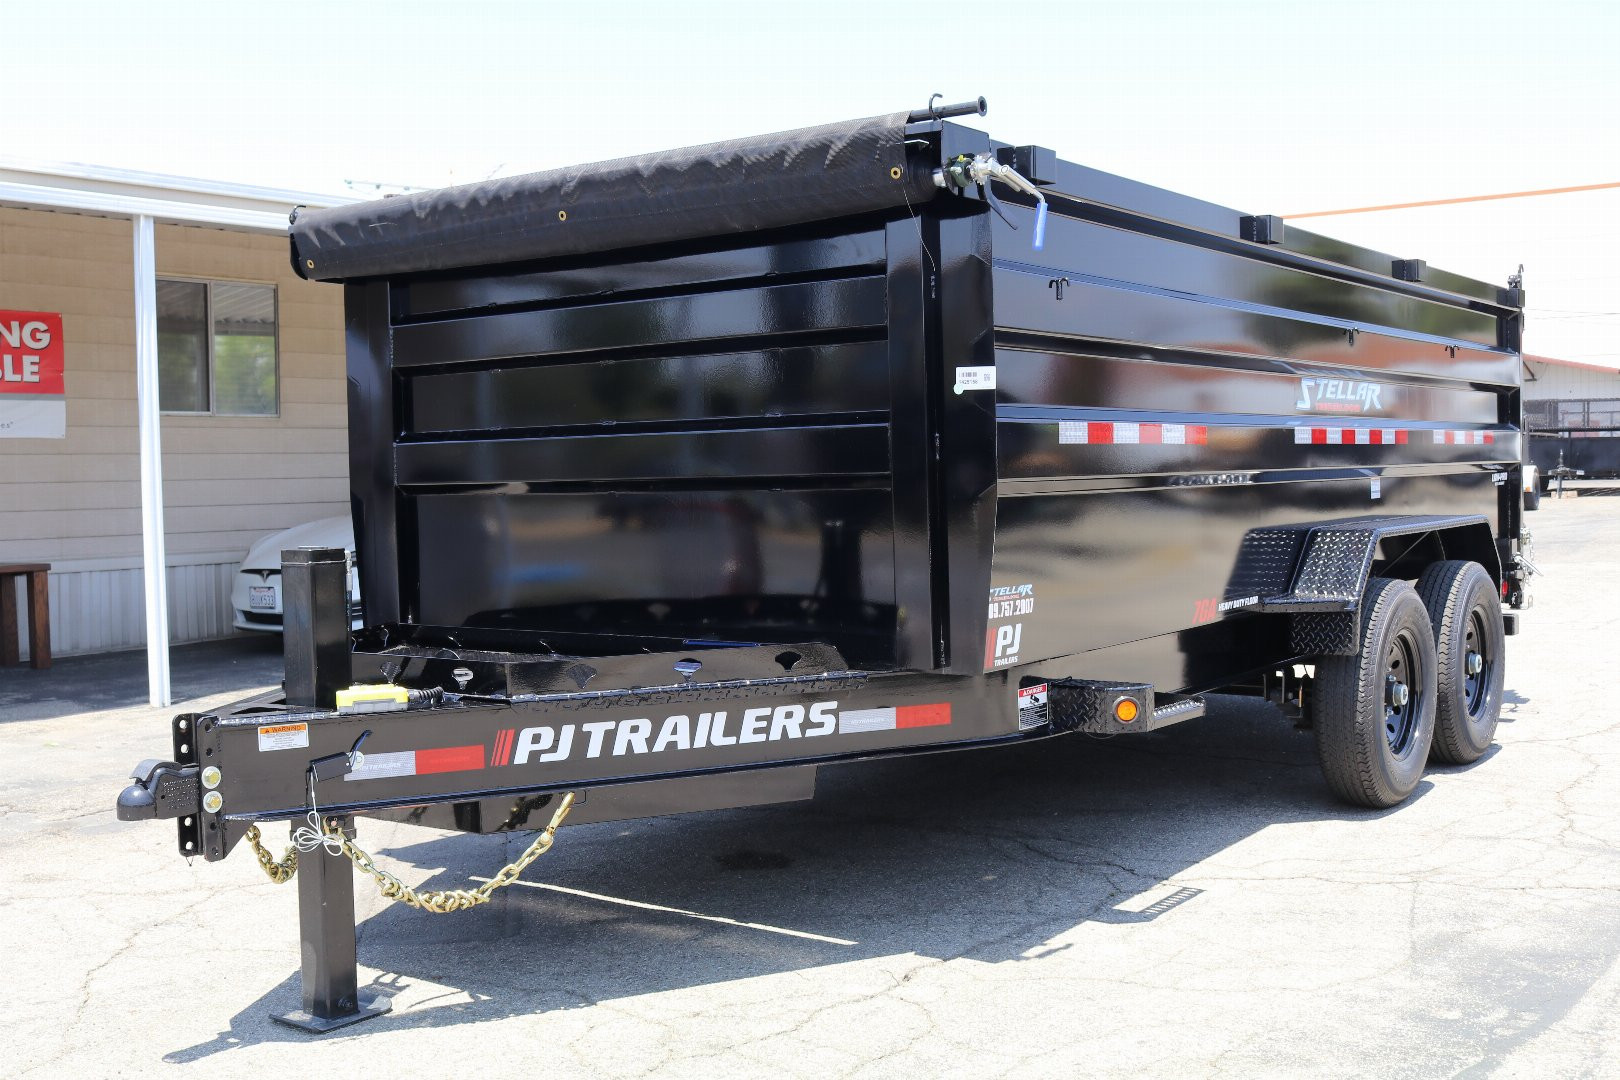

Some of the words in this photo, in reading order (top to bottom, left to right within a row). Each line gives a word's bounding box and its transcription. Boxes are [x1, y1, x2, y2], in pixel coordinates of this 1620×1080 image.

[0, 354, 40, 382] LE
[1295, 377, 1382, 411] STELLAR
[1218, 601, 1233, 612] HEAVY
[1233, 598, 1246, 609] DUTY
[995, 623, 1022, 657] PJ
[994, 656, 1018, 667] TRAILERS
[271, 725, 302, 733] WARNING
[513, 724, 576, 765] PJ
[582, 700, 838, 759] TRAILERS
